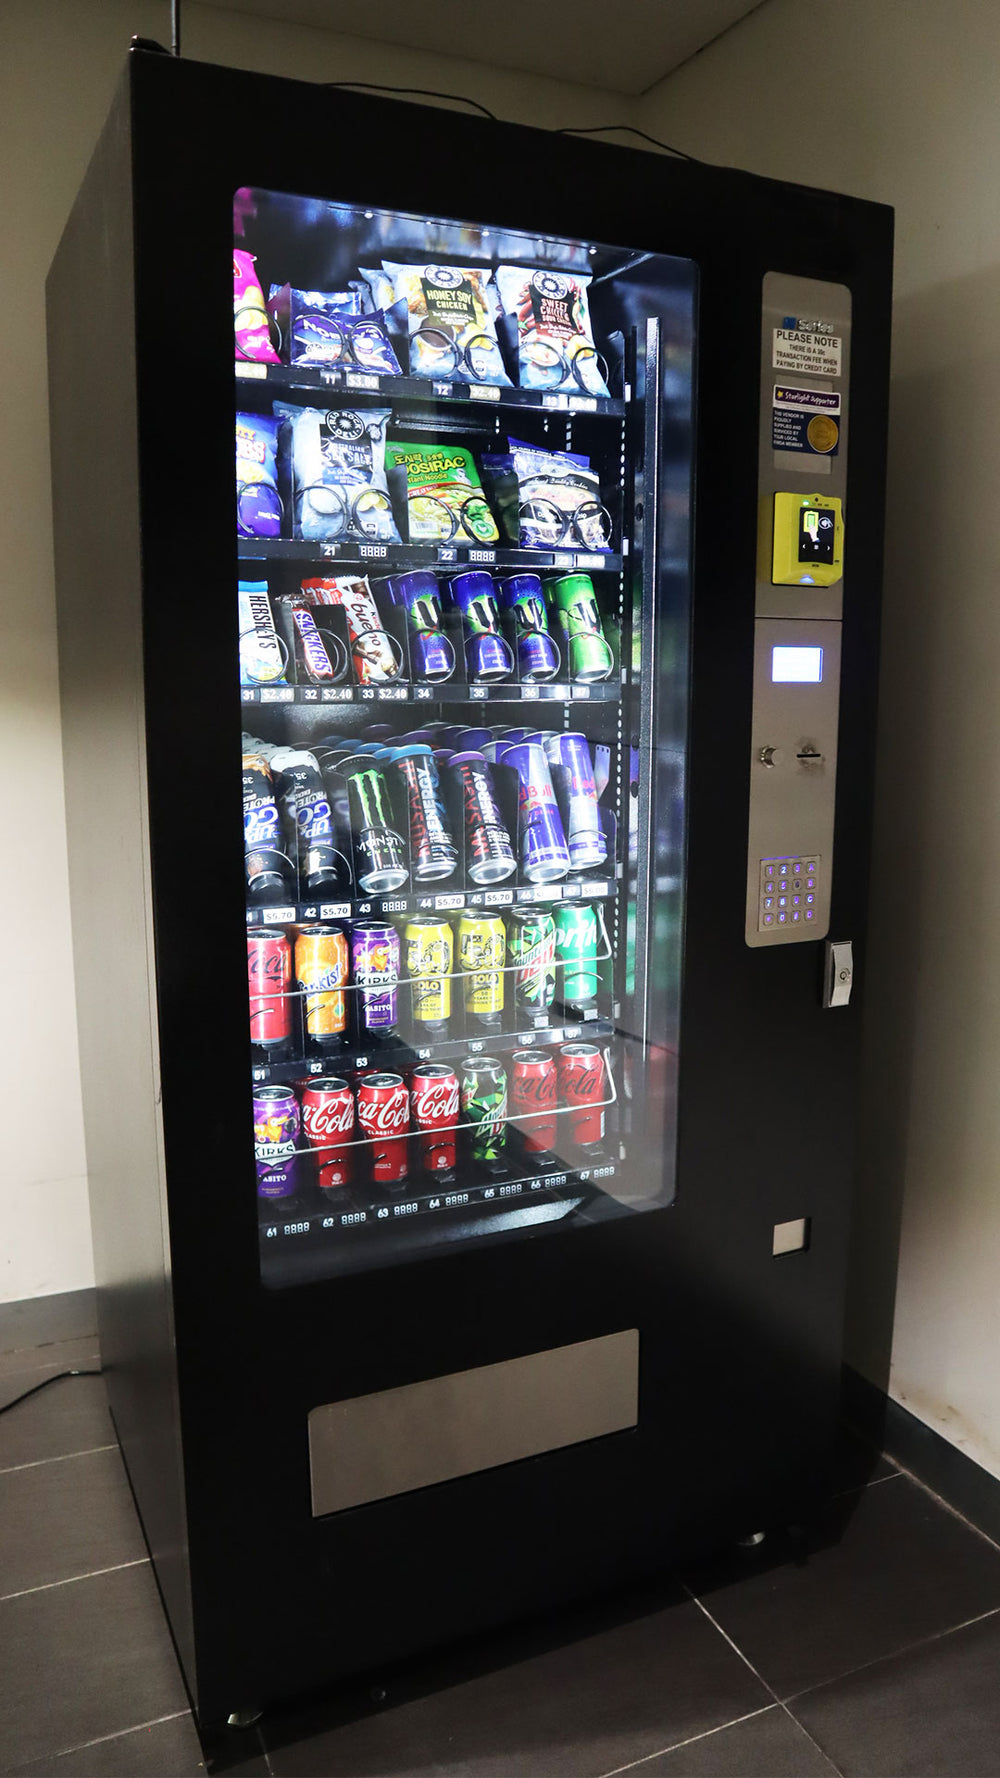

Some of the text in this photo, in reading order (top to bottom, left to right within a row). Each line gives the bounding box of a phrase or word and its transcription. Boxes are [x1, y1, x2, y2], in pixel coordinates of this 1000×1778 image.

[426, 290, 472, 304] HONEY SOY
[436, 300, 468, 311] CHICKEN
[541, 298, 568, 312] SWEET
[776, 330, 838, 348] PLEASE NOTE
[789, 344, 806, 352] THERE
[776, 350, 811, 362] TRANSACTION
[823, 358, 837, 366] WHEN
[776, 360, 795, 368] PAYING
[804, 364, 822, 372] CREDIT
[823, 366, 837, 374] CARD
[325, 374, 336, 384] 11
[437, 385, 448, 395] 12
[394, 453, 423, 465] 도시락
[324, 546, 387, 556] 21 8888
[441, 550, 494, 561] 22 8888
[350, 604, 381, 646] bueno
[300, 613, 331, 673] SNICKERS
[243, 688, 292, 700] 31 $2.40
[305, 688, 352, 699] 32 $2.40
[362, 688, 407, 699] 33 $2.40
[418, 688, 430, 698] 34
[473, 688, 484, 697] 35
[524, 688, 536, 697] 36
[576, 688, 585, 696] 37
[416, 767, 443, 833] ENERGY
[780, 864, 787, 875] 2
[420, 898, 462, 908] 44 $5.70
[471, 894, 510, 904] 45 $5.70
[304, 907, 348, 918] 42 $5.70
[359, 901, 407, 913] 43 8888
[266, 912, 292, 921] $5.70
[471, 1043, 483, 1052] 55
[419, 1049, 431, 1059] 54
[310, 1063, 322, 1073] 52
[356, 1058, 368, 1067] 53
[254, 1071, 265, 1080] 51
[259, 1174, 287, 1182] ASITO
[580, 1167, 615, 1180] 67 8888
[531, 1176, 566, 1189] 66 8888
[484, 1184, 522, 1198] 65 8888
[429, 1194, 468, 1208] 64 8888
[378, 1203, 418, 1218] 63 8888
[323, 1212, 366, 1228] 62 8888
[266, 1222, 310, 1237] 61 8888
